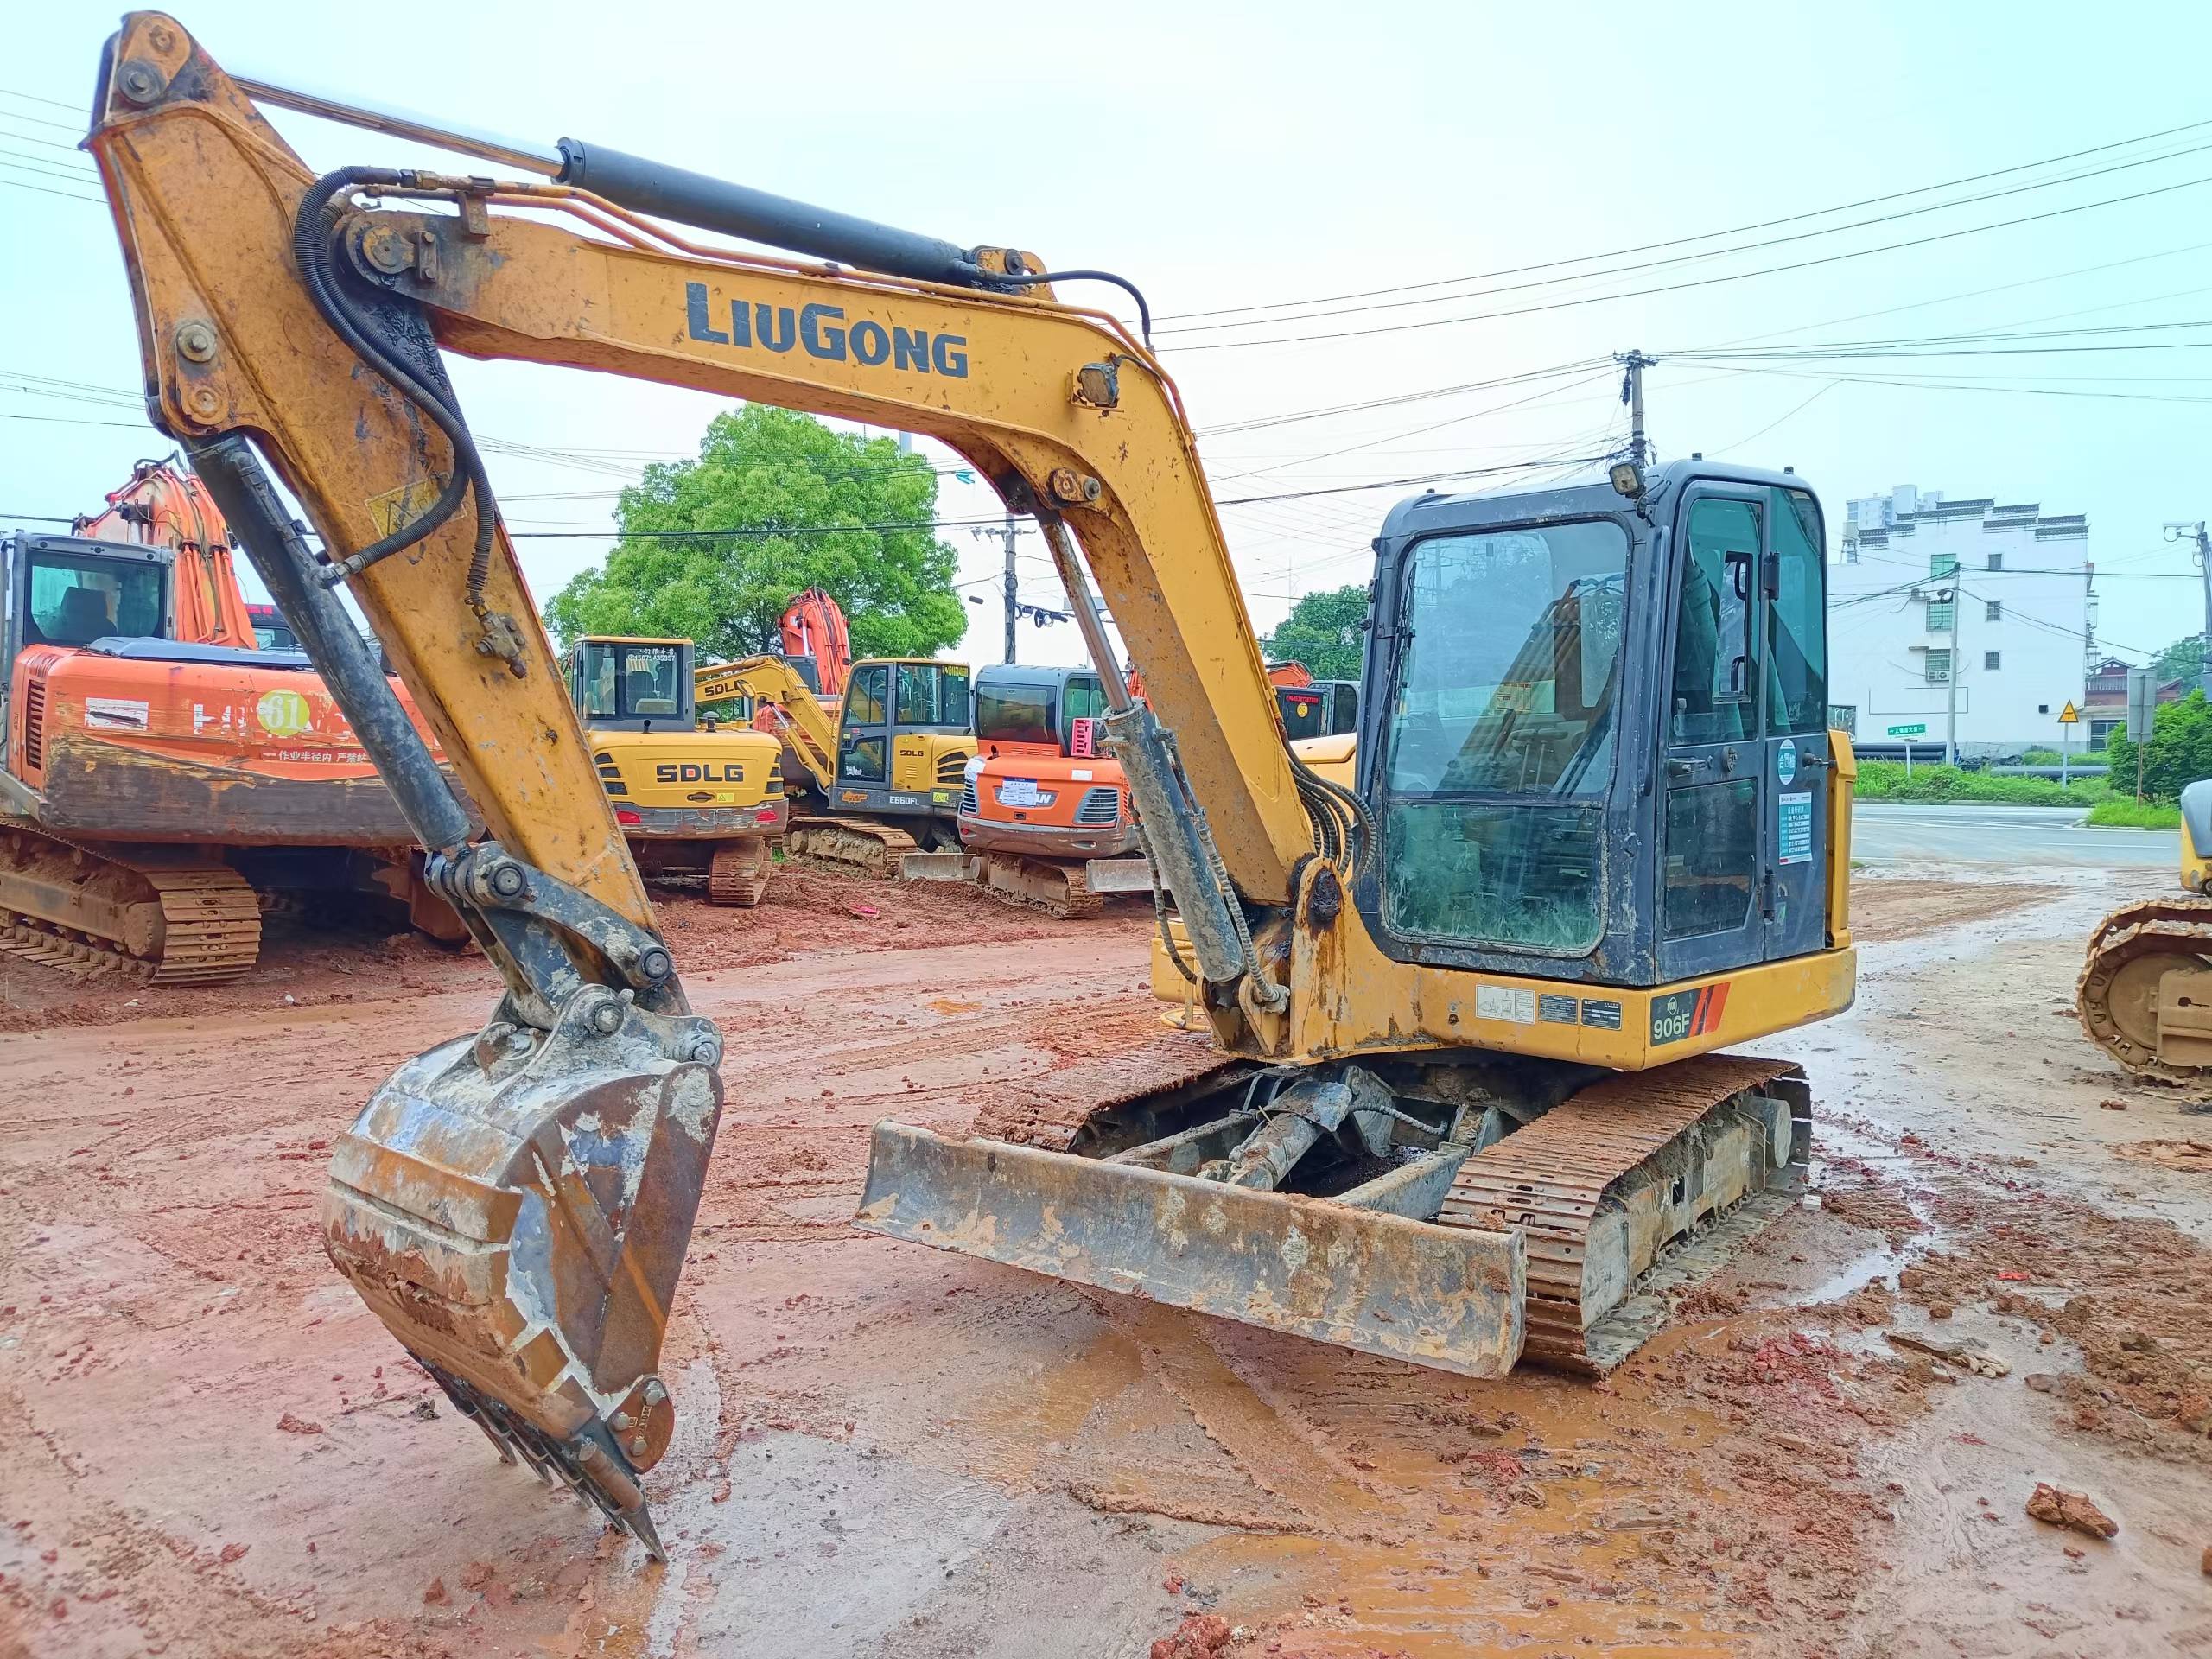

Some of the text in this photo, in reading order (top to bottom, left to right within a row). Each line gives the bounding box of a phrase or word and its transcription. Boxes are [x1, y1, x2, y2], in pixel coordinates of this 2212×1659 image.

[266, 695, 301, 729] 61
[278, 750, 332, 762] 作业半径内
[656, 764, 744, 783] SDLG
[889, 795, 920, 805] E660FL
[1653, 1012, 1690, 1040] 906F
